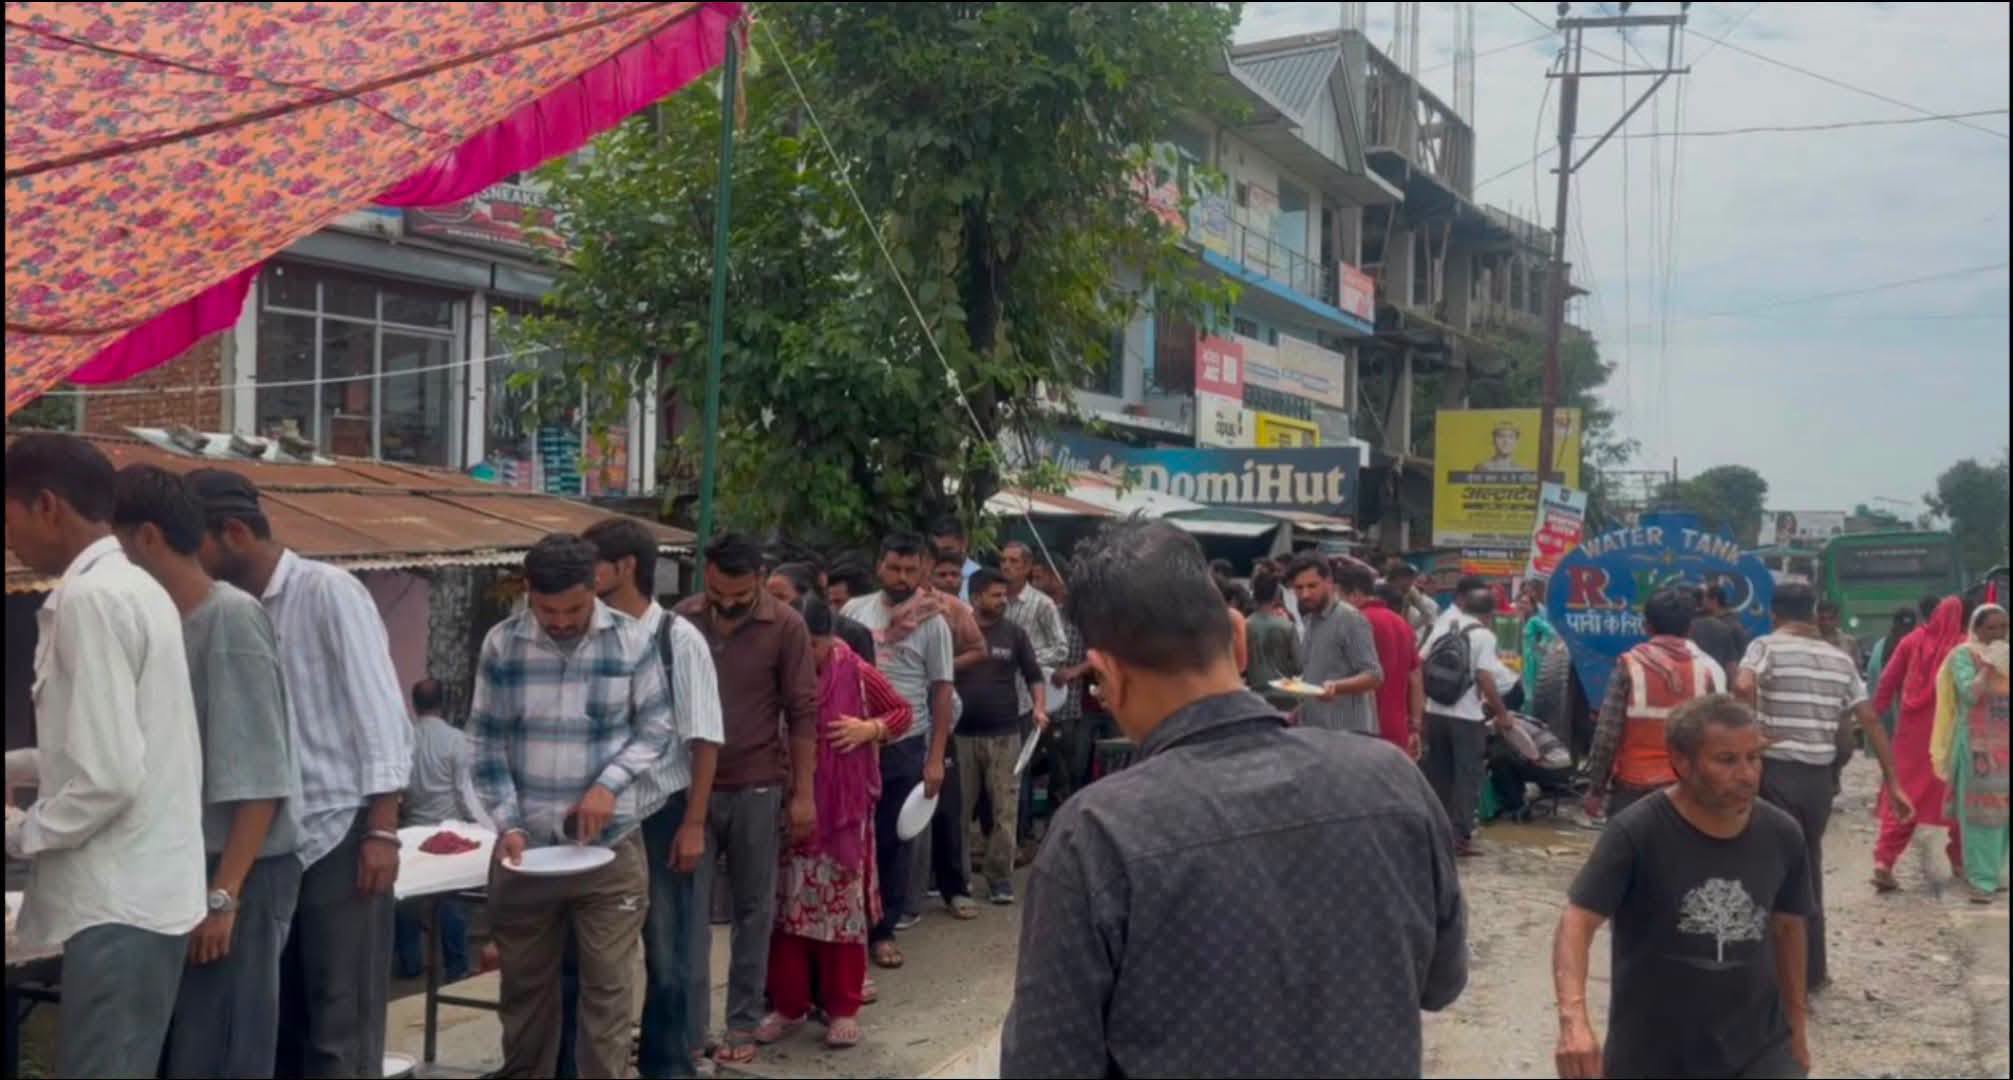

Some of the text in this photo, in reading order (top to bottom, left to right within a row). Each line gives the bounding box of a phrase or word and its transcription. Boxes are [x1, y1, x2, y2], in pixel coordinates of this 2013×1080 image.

[1141, 459, 1345, 503] DomiHut
[1580, 526, 1741, 566] WATER TANK
